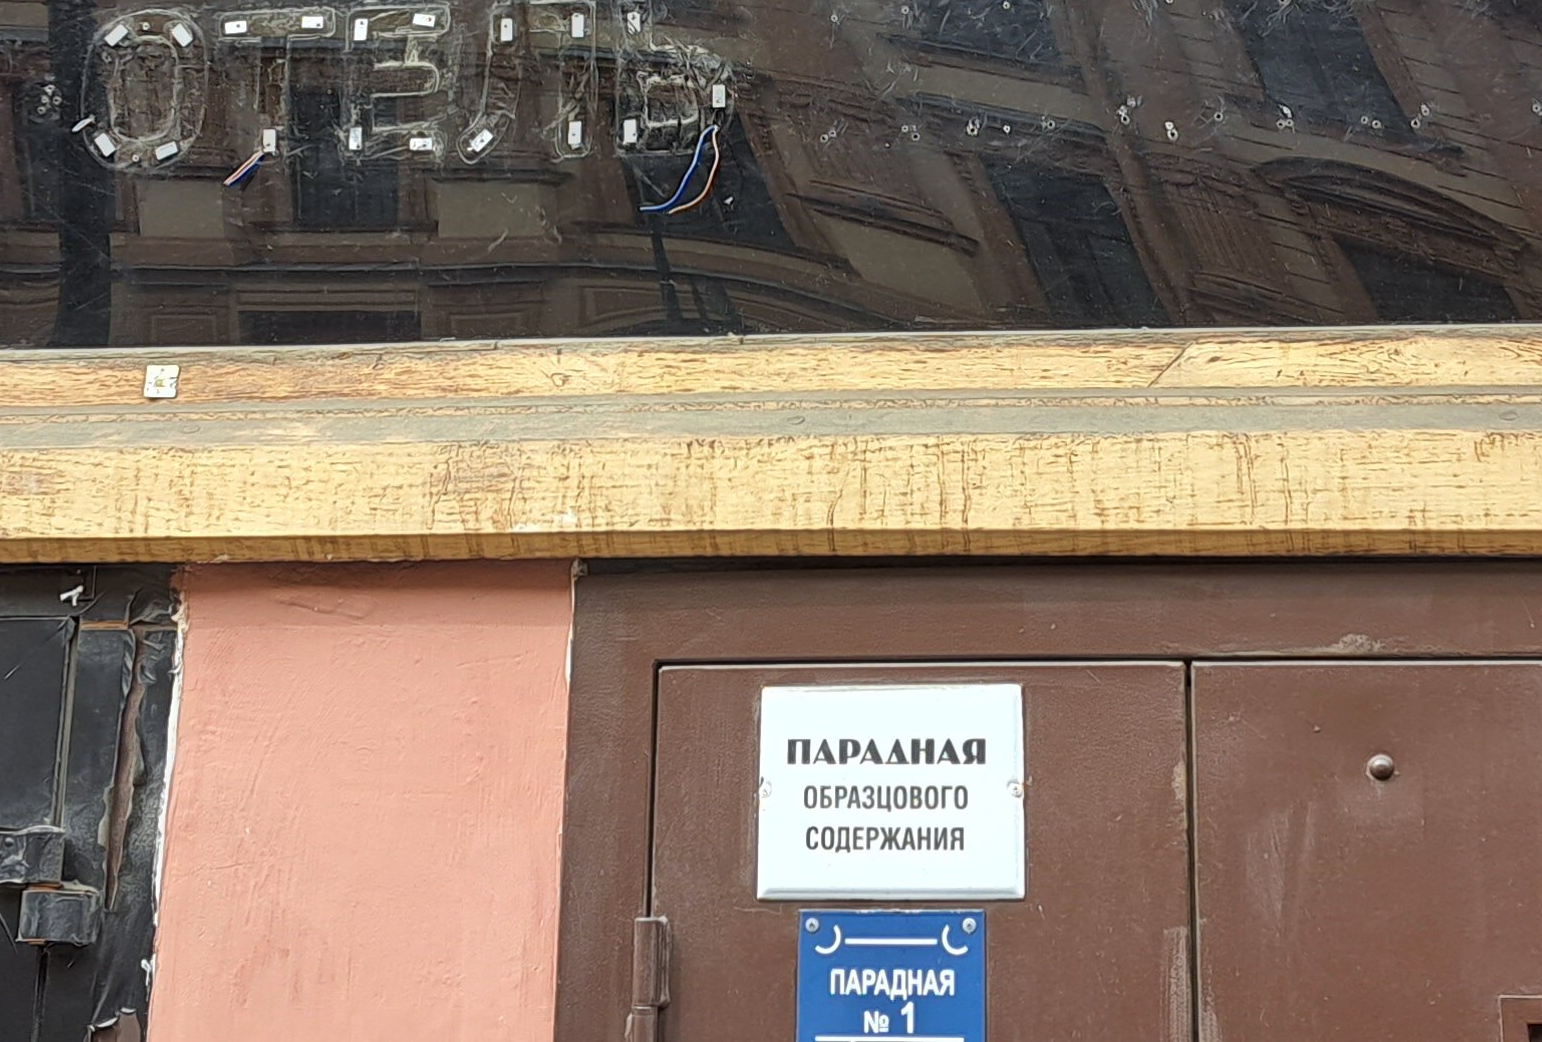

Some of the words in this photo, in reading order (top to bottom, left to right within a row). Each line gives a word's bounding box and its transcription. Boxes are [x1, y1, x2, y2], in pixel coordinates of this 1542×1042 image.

[786, 738, 987, 766] ПАРАДНАЯ
[803, 784, 969, 812] ОБРАЗЦОВОГО
[805, 826, 965, 854] СОДЕРЖАНИЯ
[830, 968, 956, 1000] ПАРАДНАЯ
[863, 1010, 890, 1034] №
[900, 1001, 915, 1034] 1
